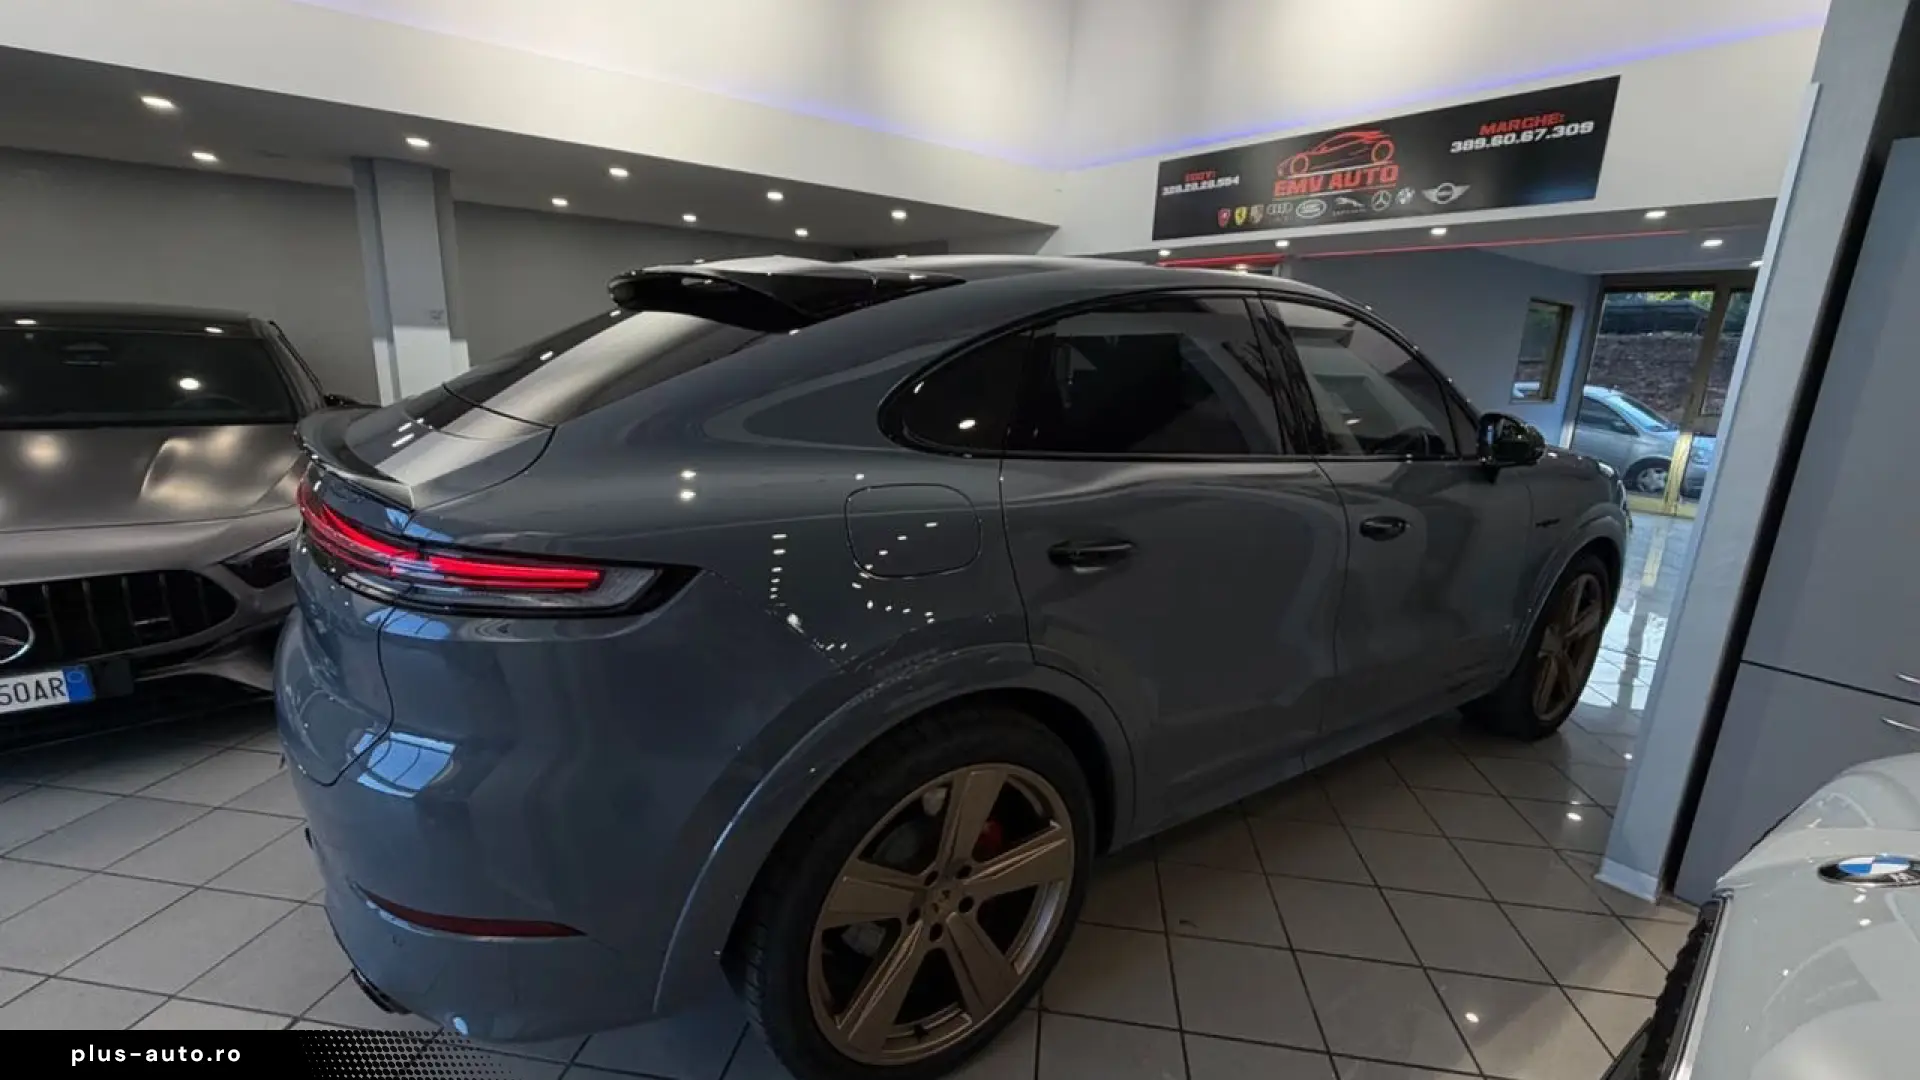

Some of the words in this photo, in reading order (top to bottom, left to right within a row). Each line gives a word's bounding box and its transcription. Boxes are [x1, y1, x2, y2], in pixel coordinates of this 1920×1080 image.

[1479, 112, 1565, 135] MARCHE:
[1274, 174, 1324, 197] EMV
[1328, 163, 1399, 191] AUTO
